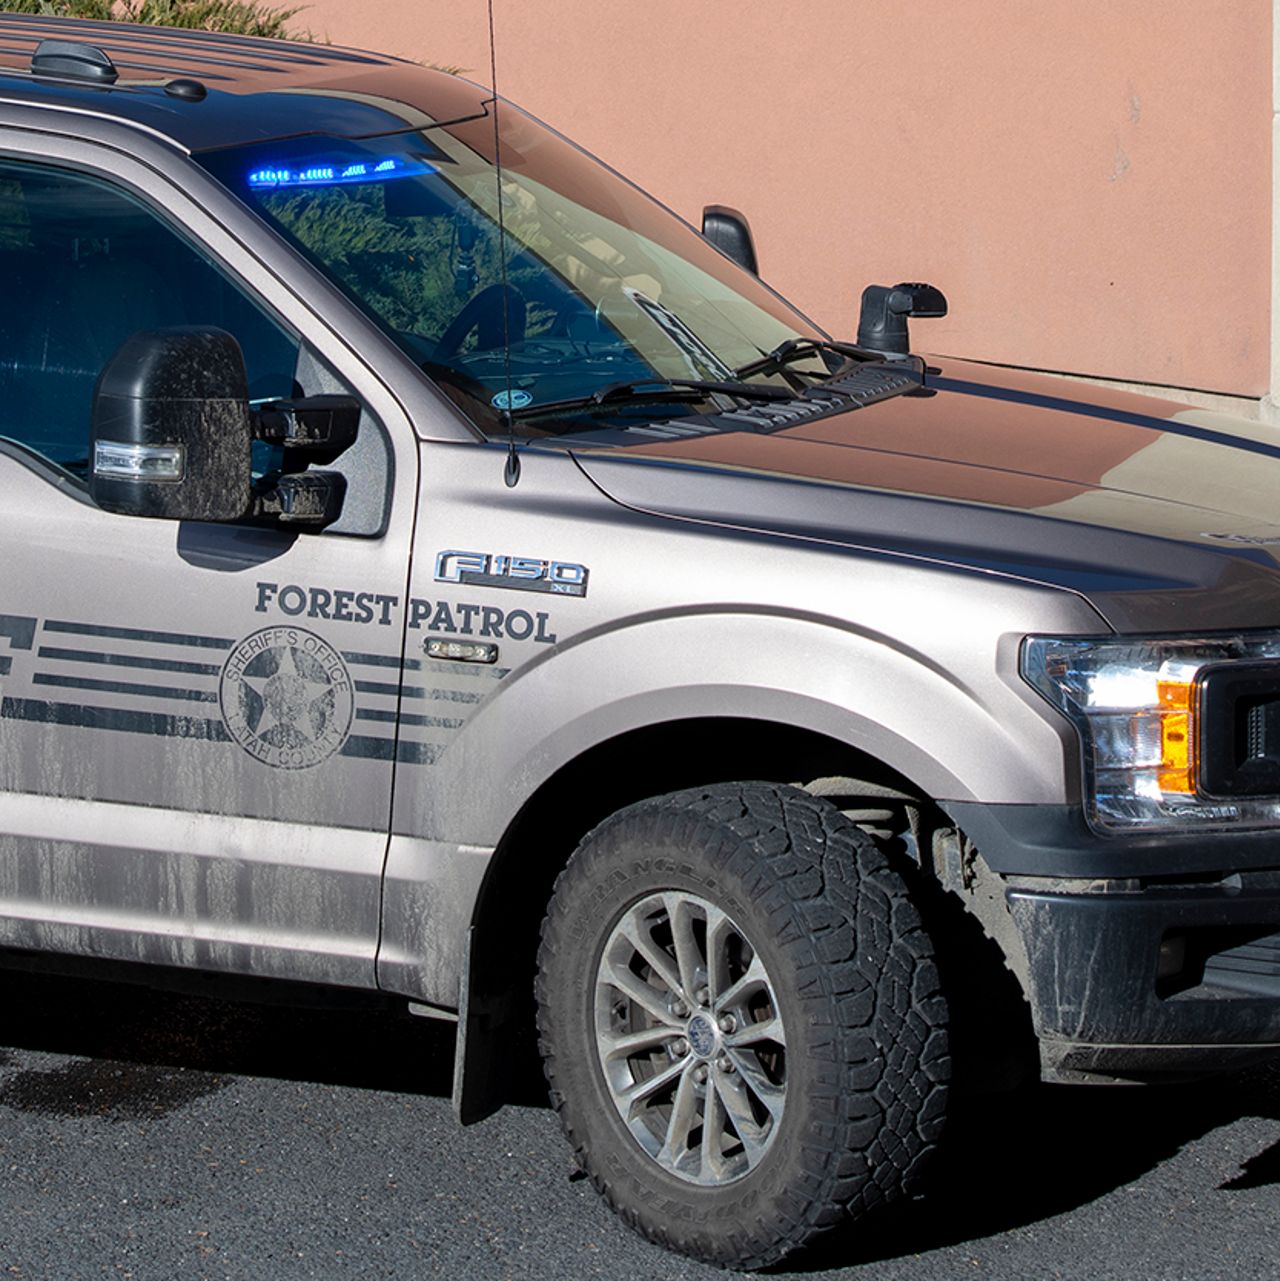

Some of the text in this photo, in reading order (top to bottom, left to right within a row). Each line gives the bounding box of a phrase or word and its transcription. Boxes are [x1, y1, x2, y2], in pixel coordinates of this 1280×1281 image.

[254, 581, 558, 644] FOREST PATROL
[225, 629, 349, 694] SHERIFF'S OFFICE
